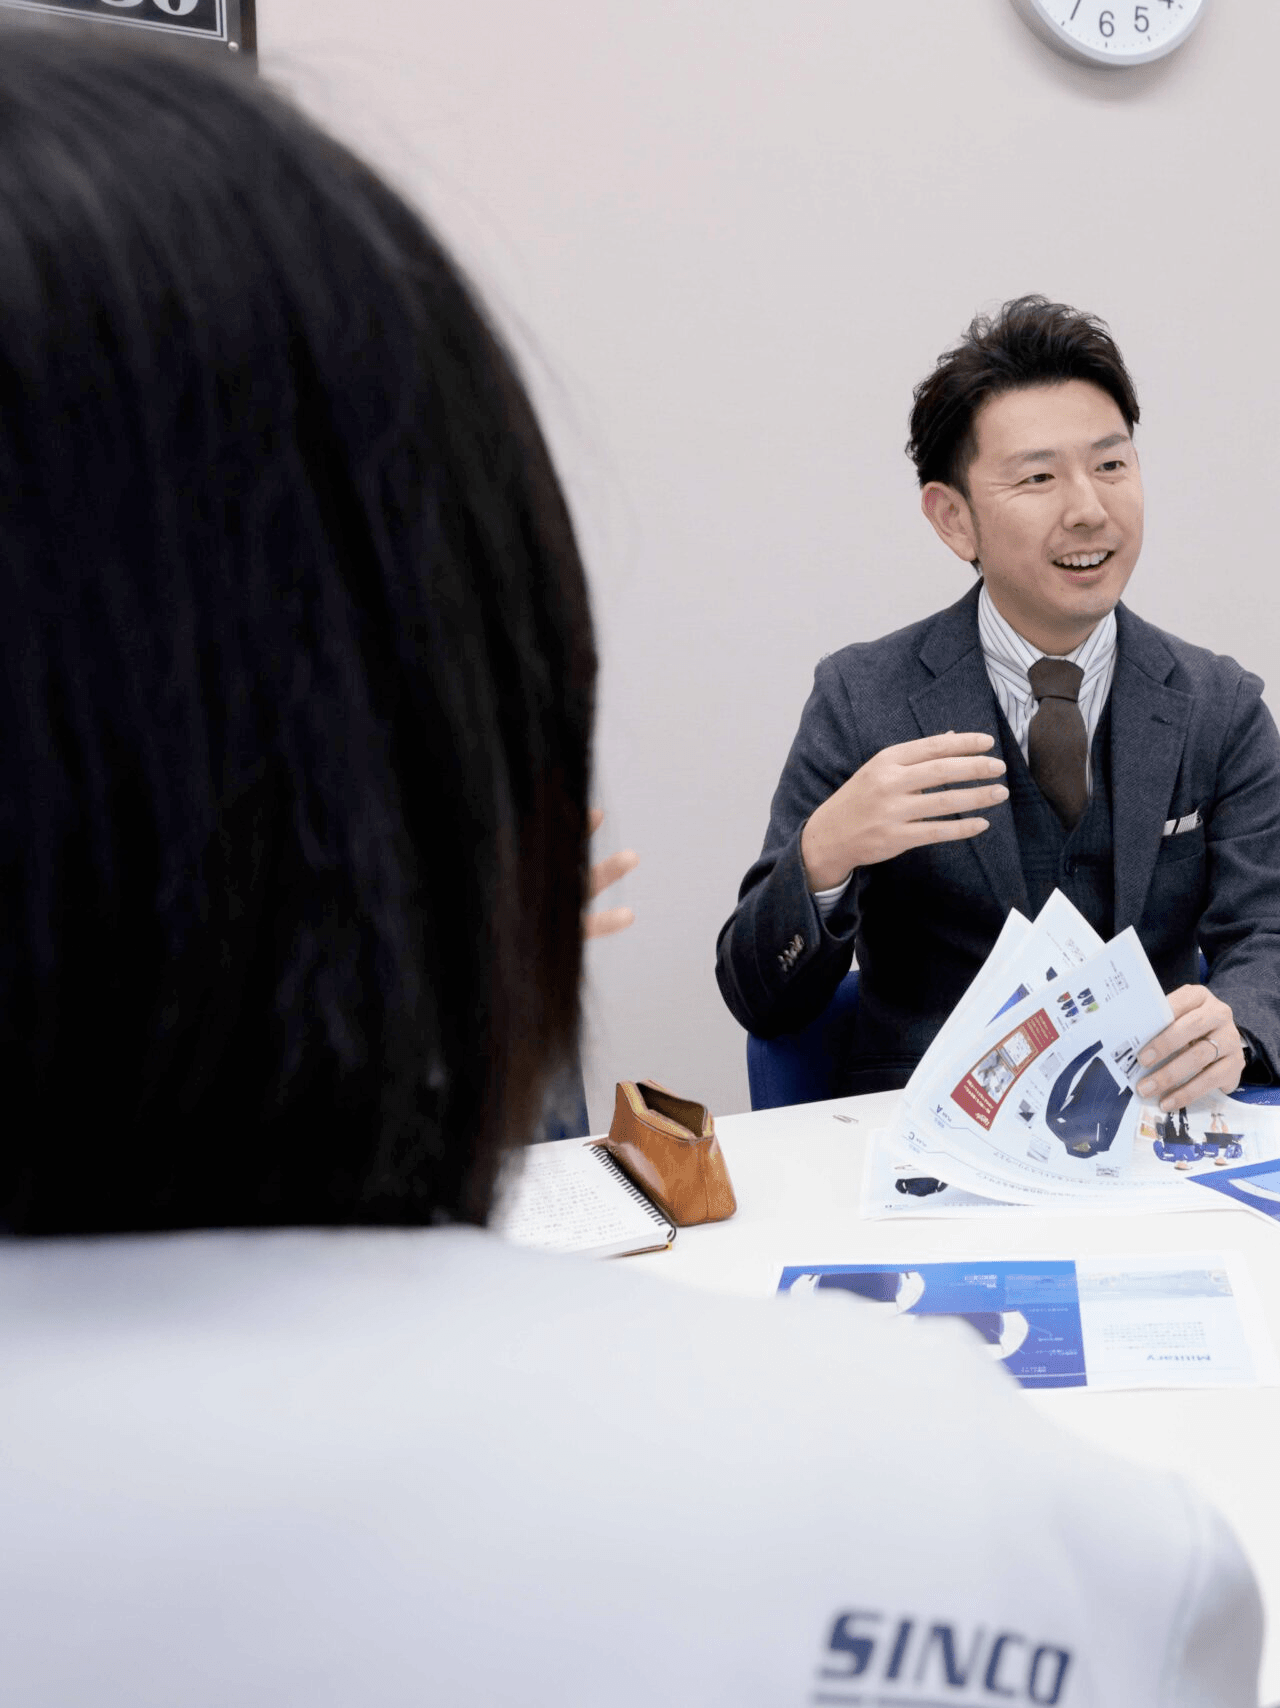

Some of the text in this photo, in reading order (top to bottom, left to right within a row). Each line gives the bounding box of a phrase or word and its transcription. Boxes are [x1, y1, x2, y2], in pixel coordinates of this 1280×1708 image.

[1100, 10, 1115, 37] 6
[1134, 6, 1149, 33] 5
[819, 1609, 1073, 1706] SINCO
